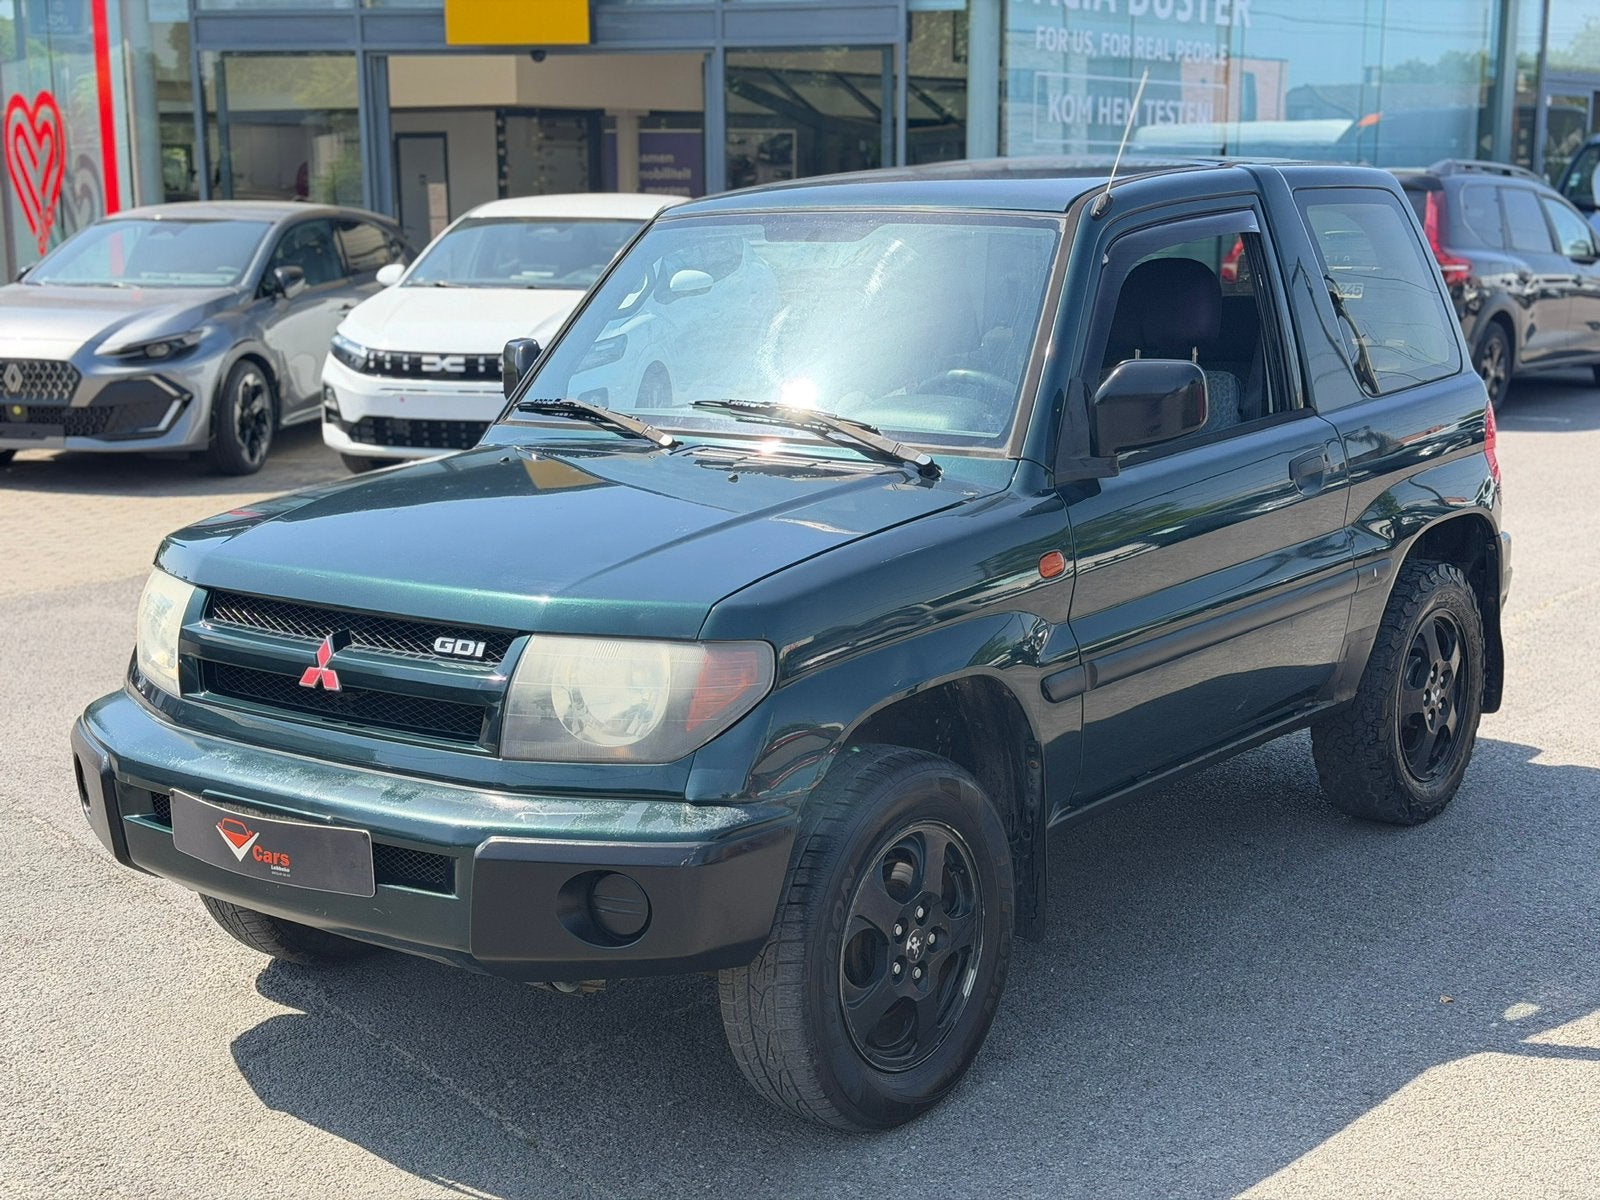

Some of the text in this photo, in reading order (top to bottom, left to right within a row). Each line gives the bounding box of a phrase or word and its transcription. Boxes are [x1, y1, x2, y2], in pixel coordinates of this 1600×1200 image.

[1036, 25, 1228, 65] FOR US, FOR REAL PEOPLE
[1048, 93, 1093, 124] KOM
[433, 636, 487, 658] GDI
[252, 844, 290, 867] Cars
